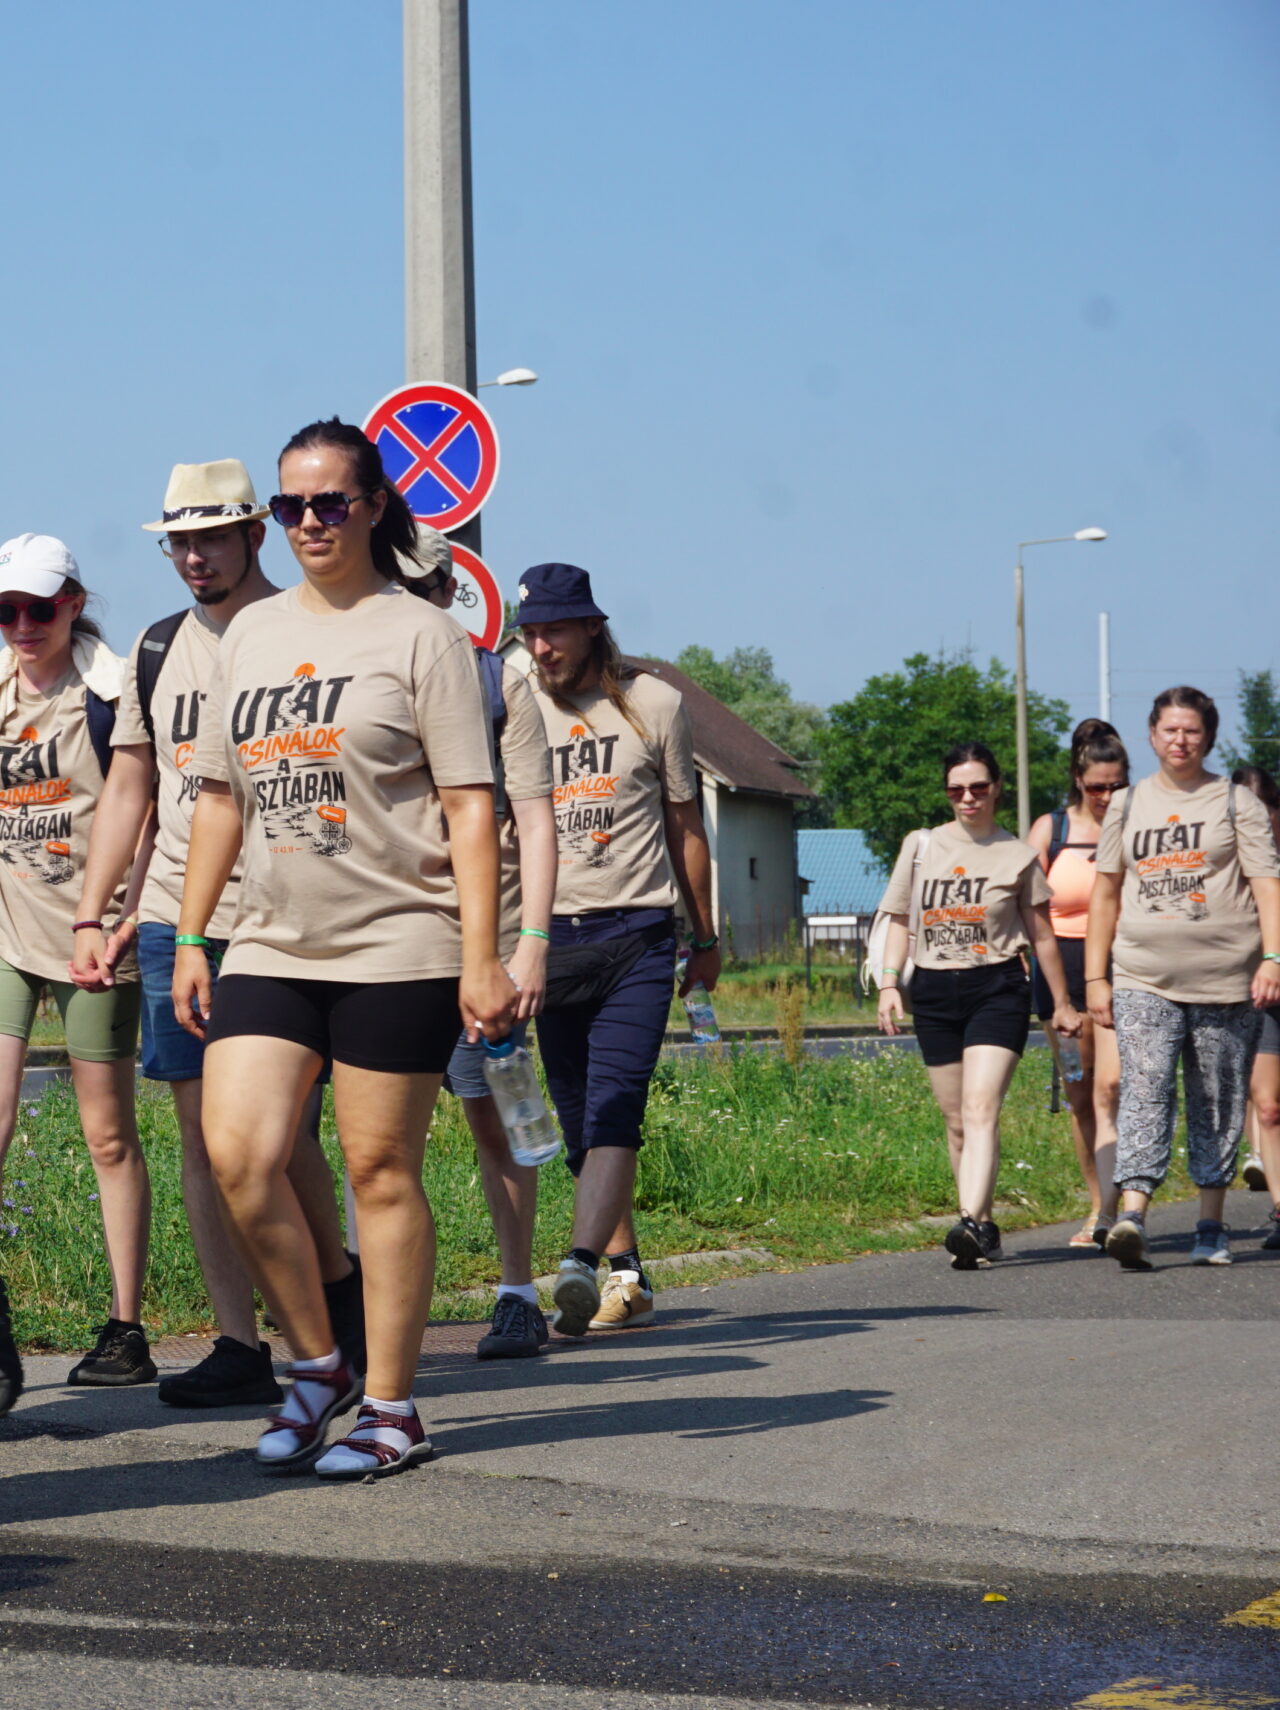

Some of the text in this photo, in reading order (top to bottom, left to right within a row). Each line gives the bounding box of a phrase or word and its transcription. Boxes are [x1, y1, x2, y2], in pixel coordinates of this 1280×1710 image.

[232, 675, 354, 745] UTAT
[236, 724, 346, 771] CSINÁLOK
[278, 758, 291, 775] A
[252, 771, 347, 813] SZTÁBAN
[1133, 822, 1205, 861] UTAT
[922, 877, 989, 911] UTAT
